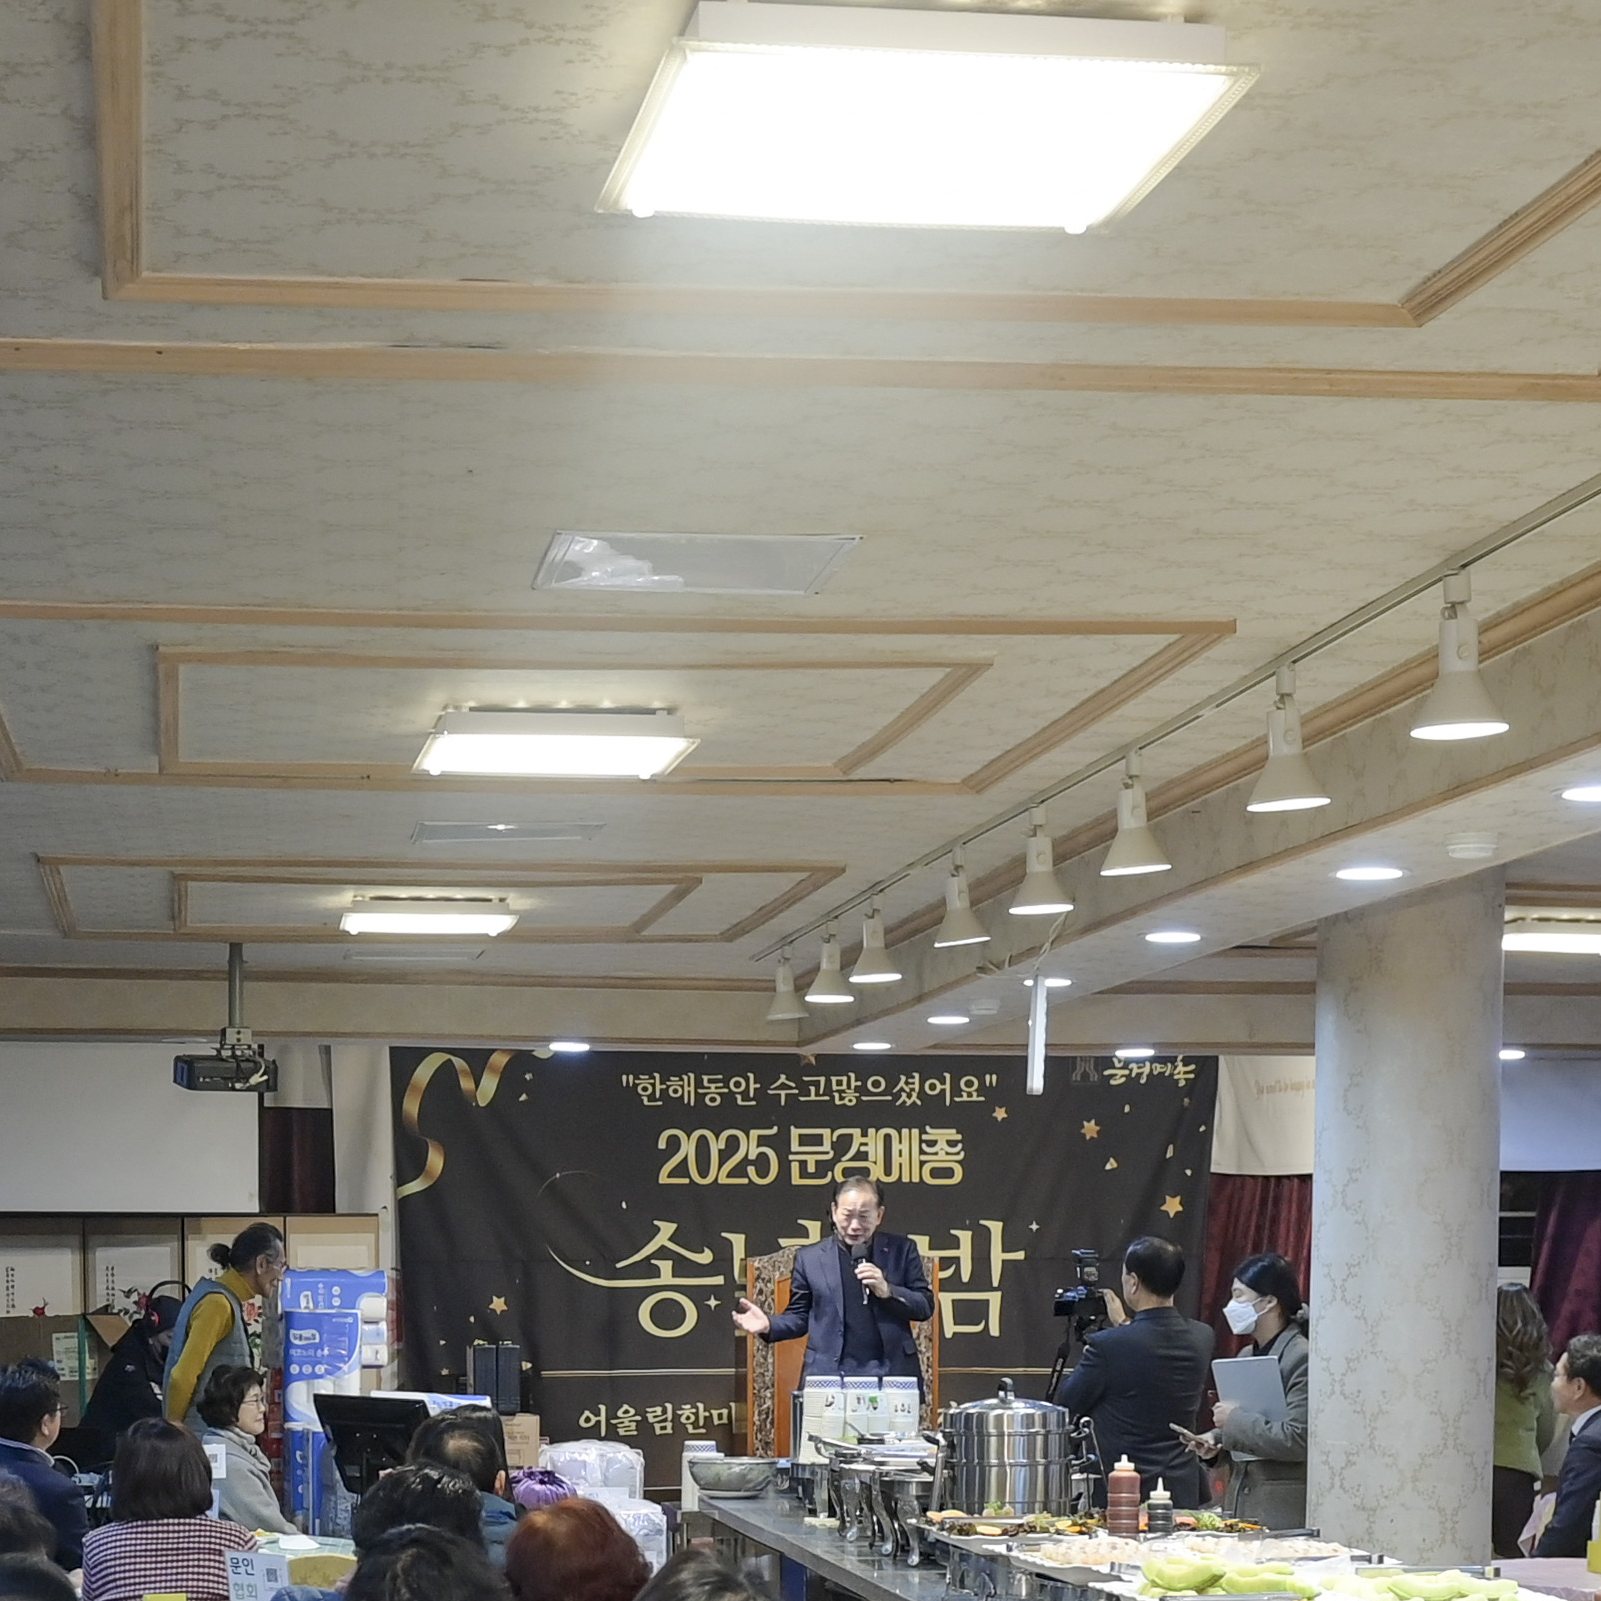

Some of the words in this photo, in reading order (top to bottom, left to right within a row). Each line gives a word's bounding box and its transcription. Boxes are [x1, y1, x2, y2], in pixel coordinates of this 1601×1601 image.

[621, 1072, 760, 1106] "한해동안
[767, 1073, 997, 1106] 수고많으셨어요"
[657, 1125, 779, 1185] 2025
[789, 1124, 965, 1185] 문경예총
[229, 1556, 255, 1576] 문인
[233, 1582, 258, 1600] 협회
